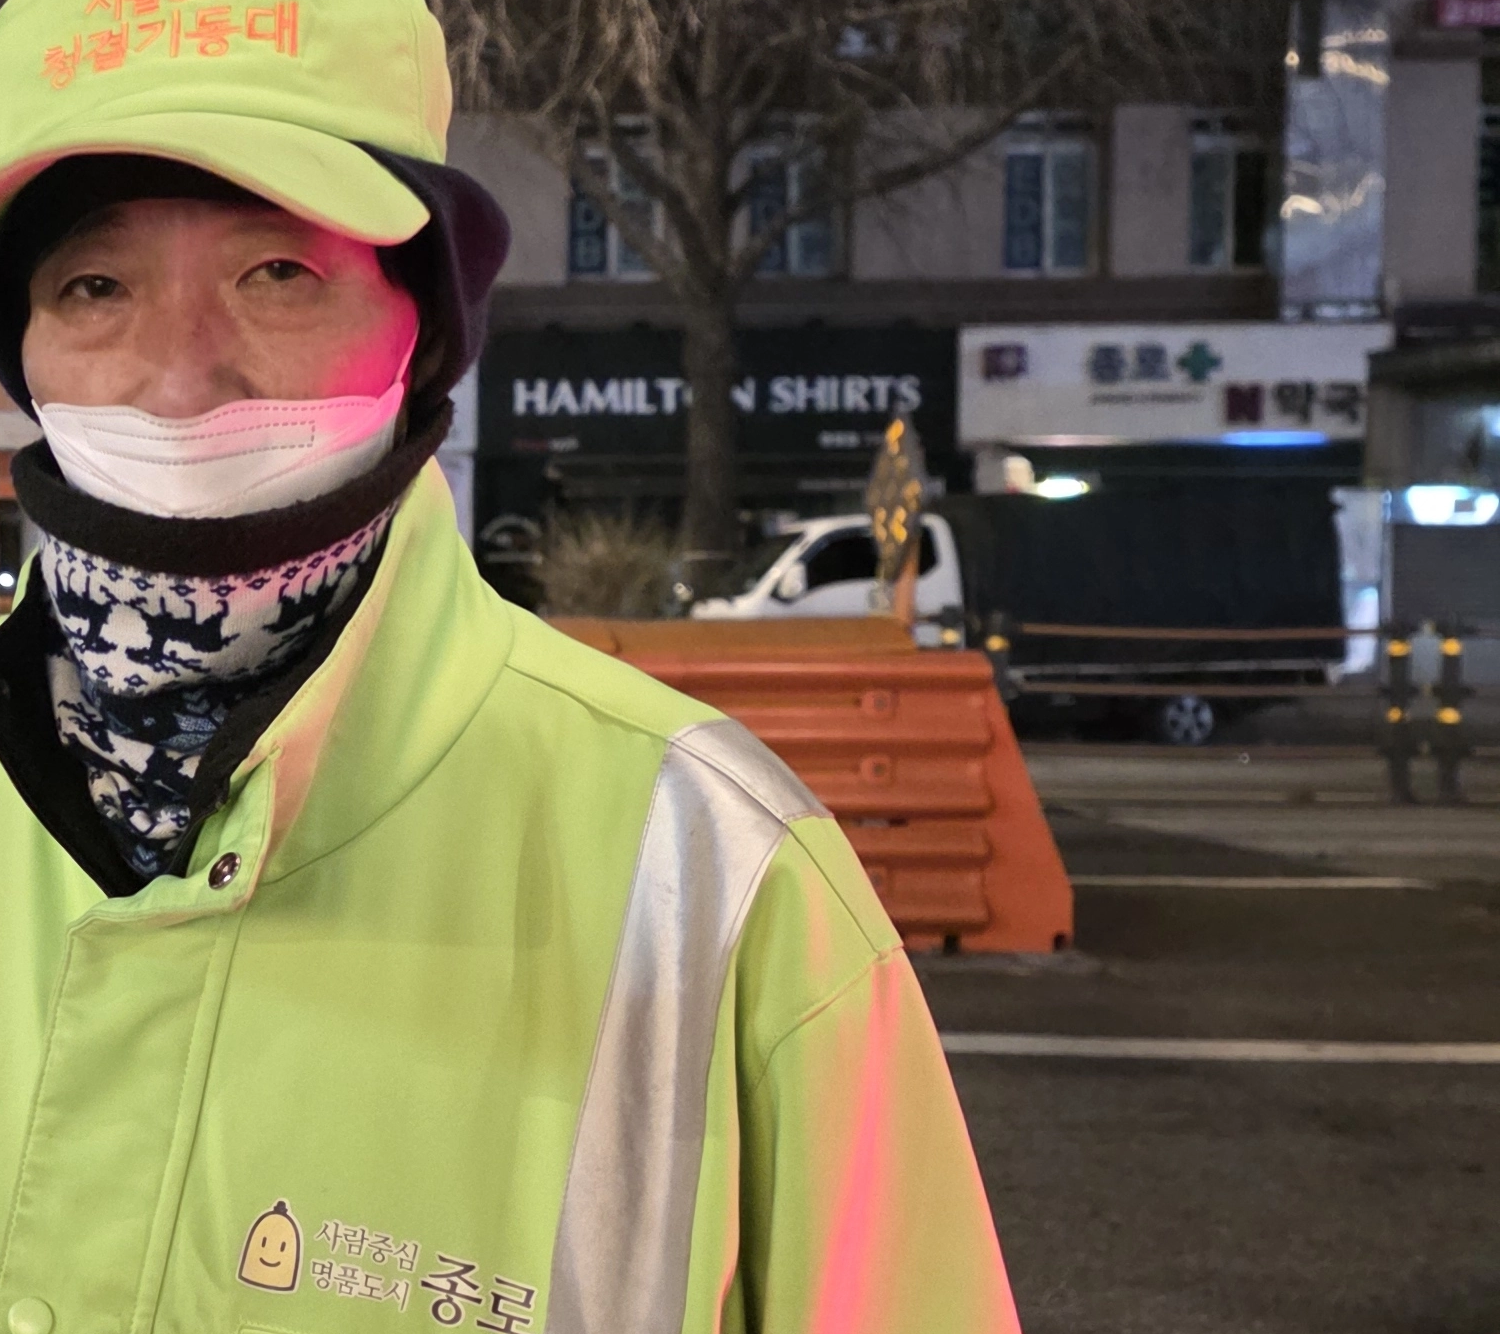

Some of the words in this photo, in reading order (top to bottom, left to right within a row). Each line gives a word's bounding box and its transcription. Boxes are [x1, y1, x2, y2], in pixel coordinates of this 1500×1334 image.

[41, 0, 300, 91] 청결기동대
[512, 377, 756, 415] HAMILTN
[769, 374, 922, 414] SHIRTS
[315, 1220, 421, 1273] 사람중심
[311, 1260, 411, 1312] 명품도시
